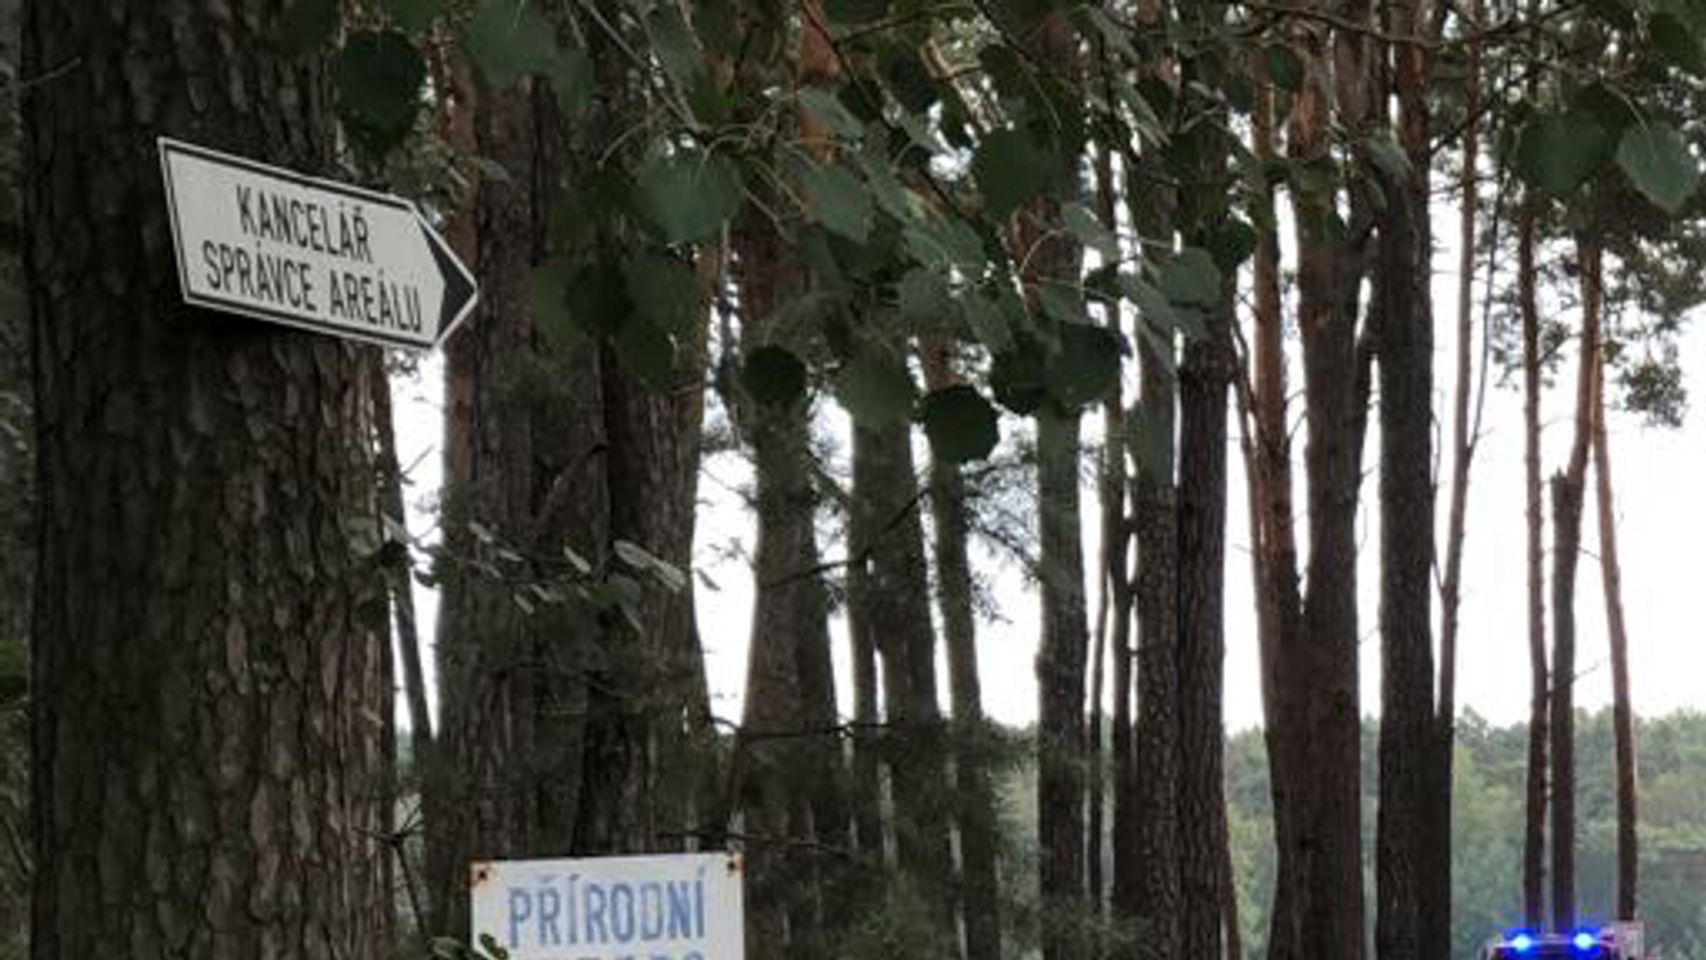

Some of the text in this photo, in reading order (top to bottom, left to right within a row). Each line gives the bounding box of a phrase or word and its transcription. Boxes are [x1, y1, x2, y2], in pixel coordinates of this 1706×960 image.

[236, 184, 374, 264] KANCELÁŘ
[202, 239, 422, 333] SPRÁVCE AREÁLU
[507, 866, 706, 949] PŘÍRODNÍ
